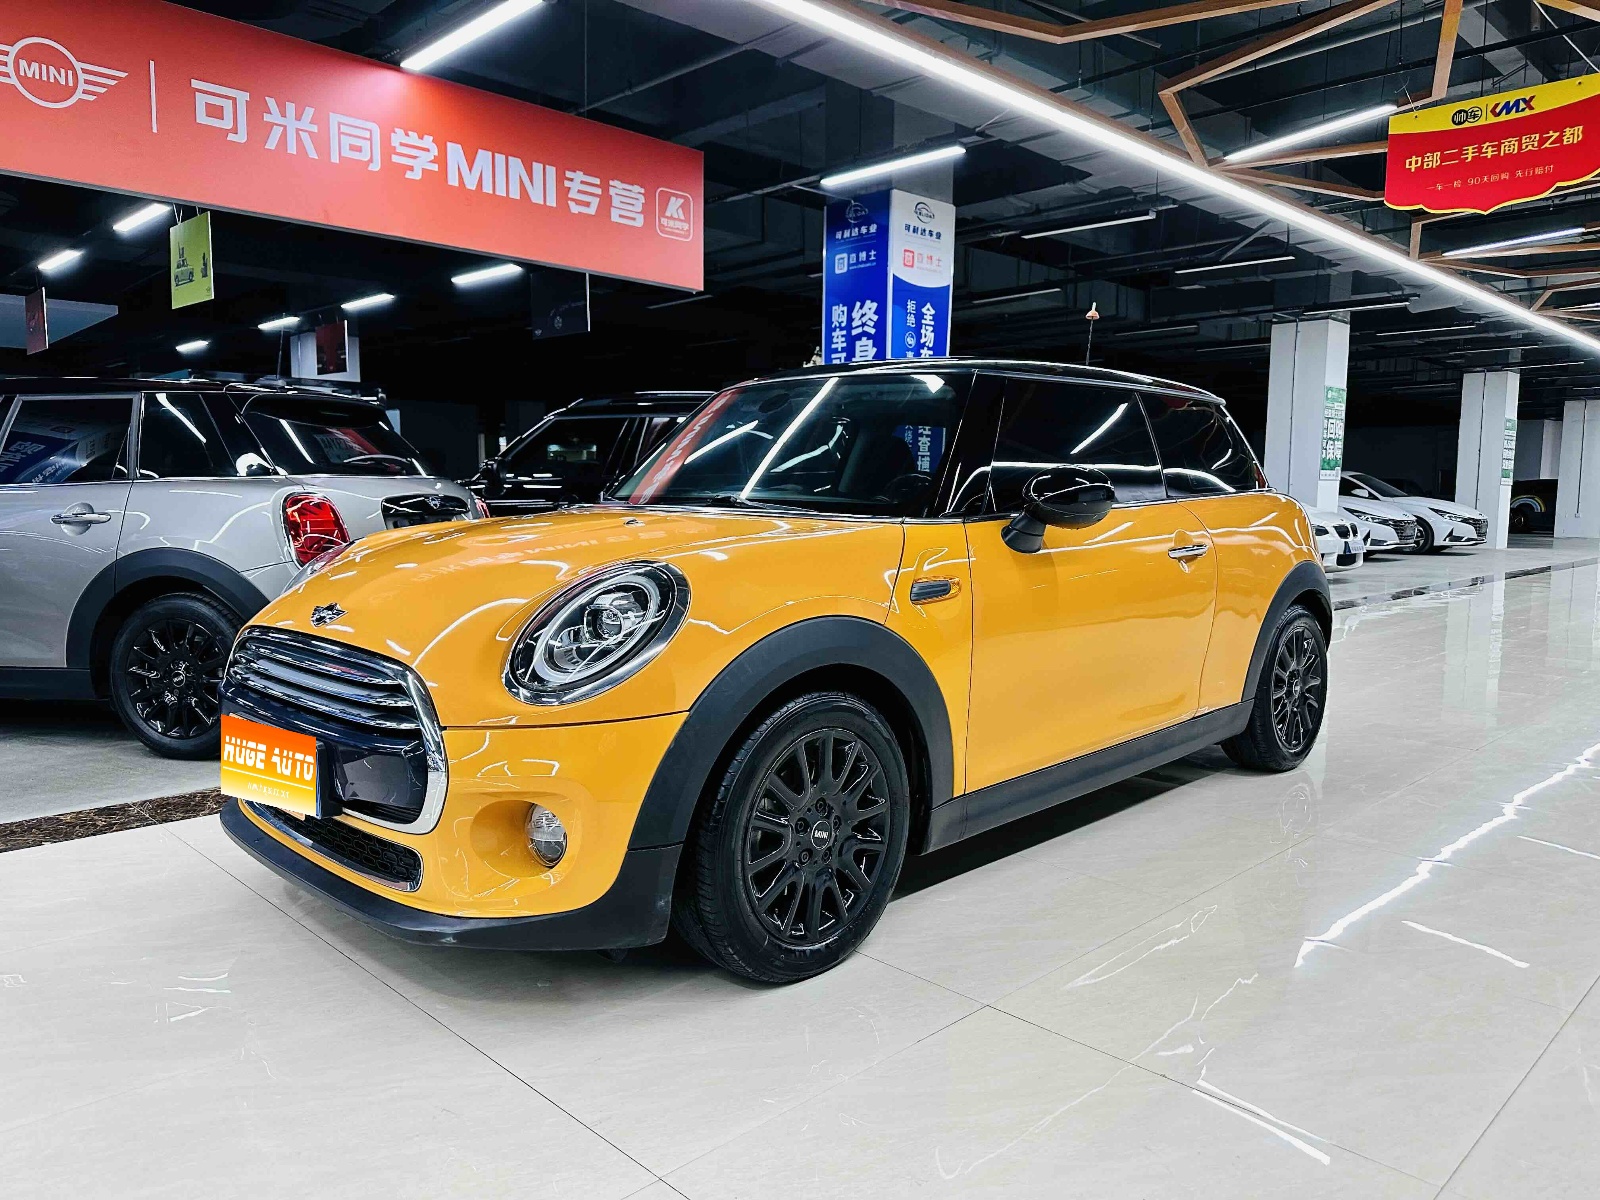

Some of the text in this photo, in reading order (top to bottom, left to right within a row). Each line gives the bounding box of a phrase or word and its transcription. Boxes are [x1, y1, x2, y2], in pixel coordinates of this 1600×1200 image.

[18, 58, 74, 87] MINI
[190, 78, 646, 229] 可米同学MINI专营
[1405, 125, 1584, 173] 中部二手车商贸之都
[1467, 172, 1510, 186] 90天回购
[904, 223, 942, 240] 可利达车业
[851, 299, 879, 361] 终身
